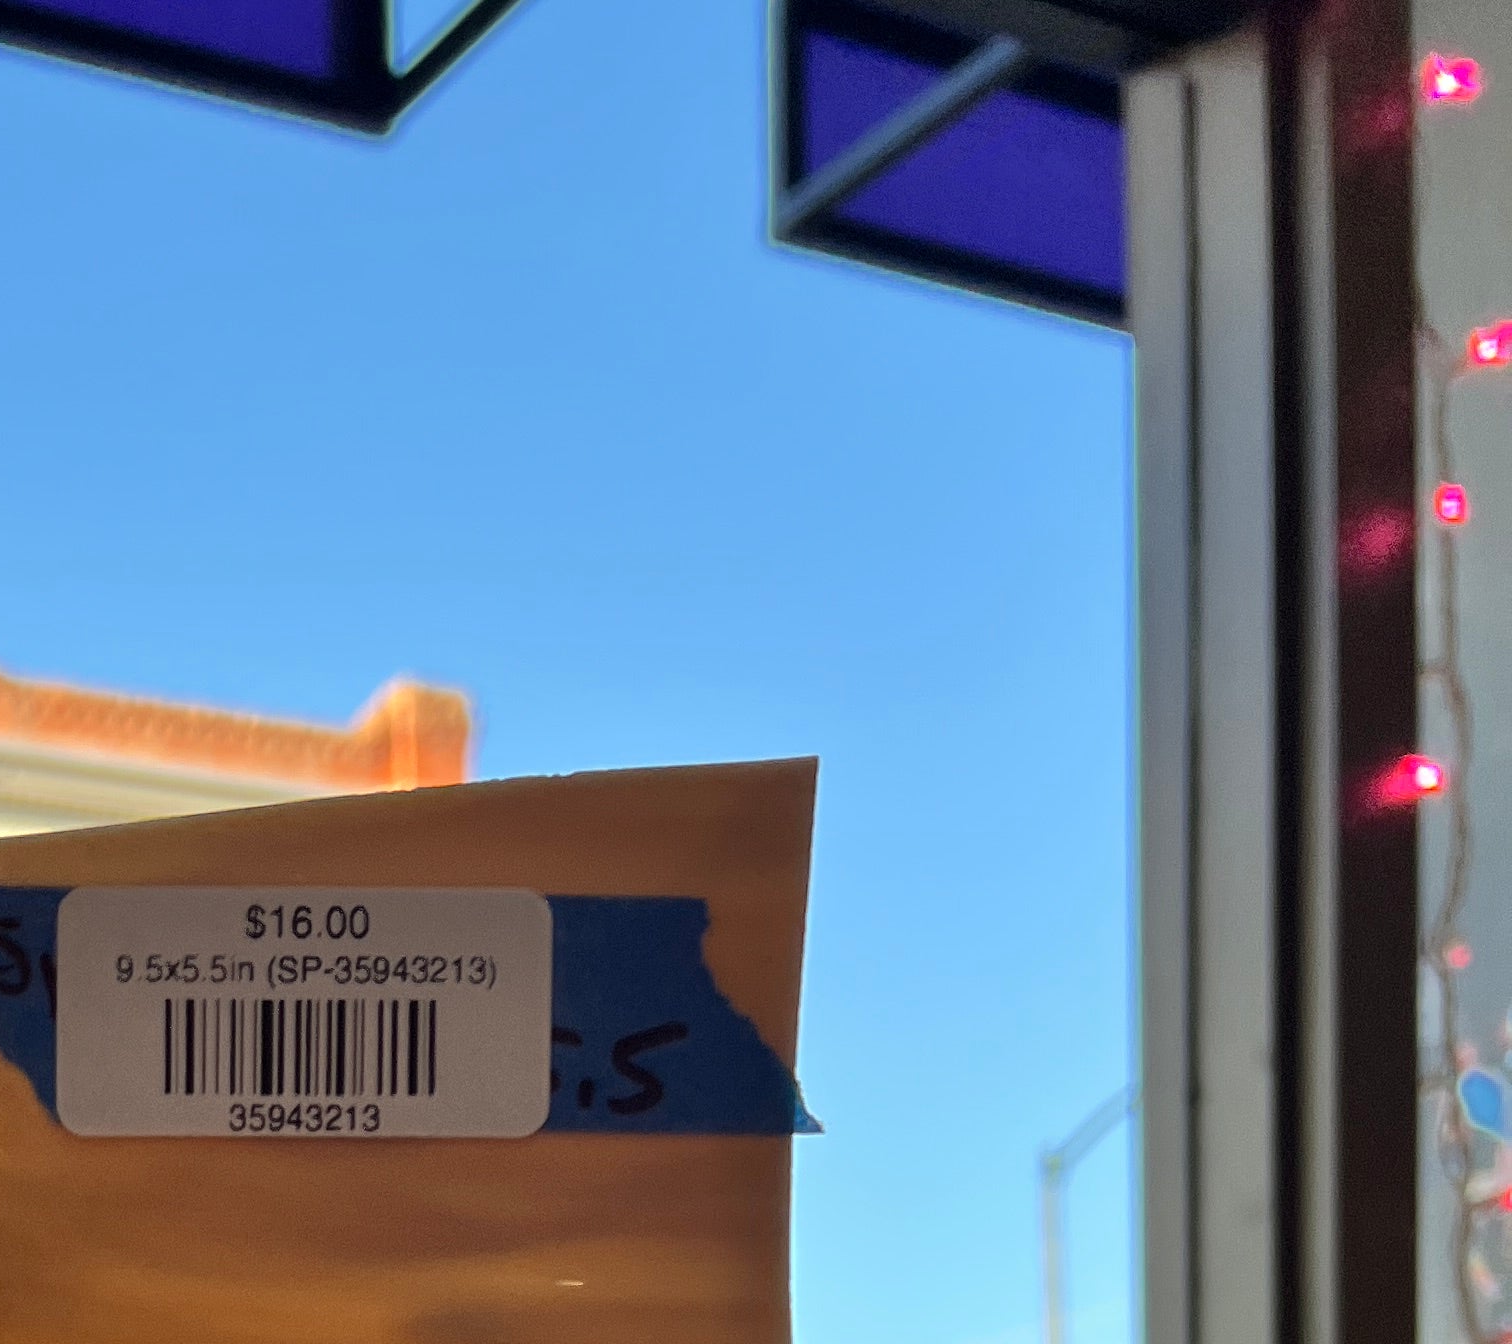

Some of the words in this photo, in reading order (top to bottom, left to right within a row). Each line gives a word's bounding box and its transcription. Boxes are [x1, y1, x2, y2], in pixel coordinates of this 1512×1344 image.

[245, 904, 370, 939] $16.00
[116, 953, 255, 984] 9.5x5.5in
[267, 954, 498, 989] (SP-35943213)
[229, 1103, 381, 1132] 35943213
